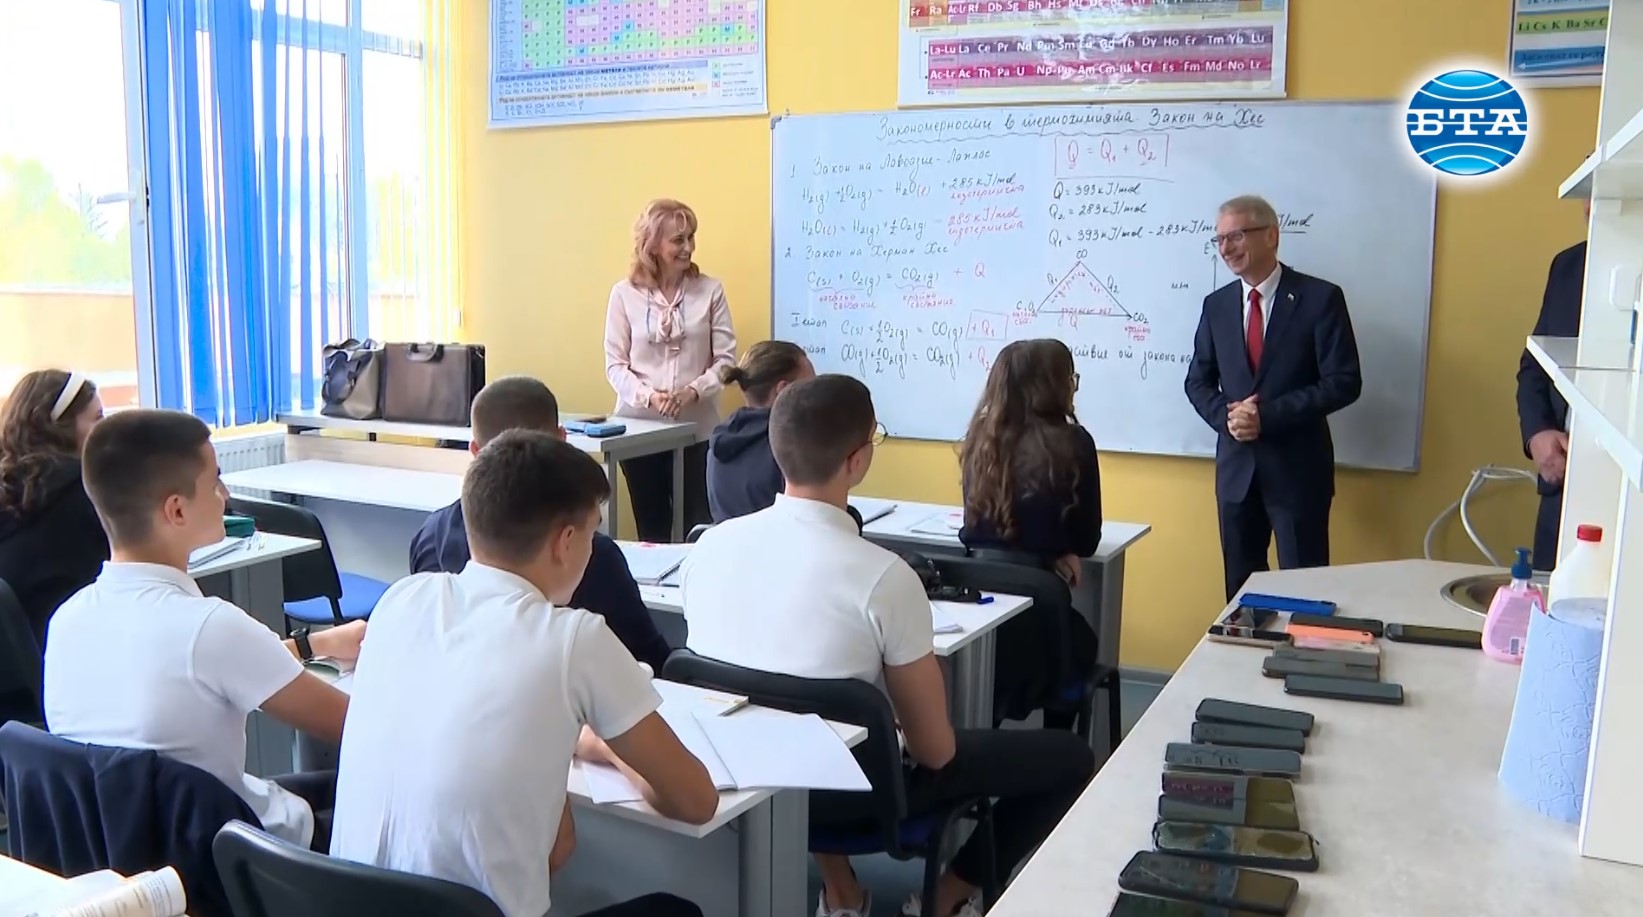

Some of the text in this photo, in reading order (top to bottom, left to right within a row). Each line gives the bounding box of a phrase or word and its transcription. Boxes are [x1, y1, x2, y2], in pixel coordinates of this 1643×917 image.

[968, 4, 979, 12] Rf
[988, 2, 1002, 12] Db
[1533, 22, 1546, 30] Cs
[1552, 20, 1560, 29] K
[930, 45, 956, 54] La-Lu
[958, 44, 970, 54] La
[978, 43, 991, 52] Ce
[998, 43, 1008, 52] Pr
[1017, 41, 1032, 51] Nd
[1142, 37, 1157, 48] Dy
[1164, 36, 1180, 47] Ho
[1207, 35, 1224, 45] Tm
[1229, 34, 1244, 44] Yb
[1251, 33, 1264, 44] Lu
[930, 69, 956, 79] Ac-Lr
[958, 69, 971, 78] Ac
[978, 68, 991, 78] Th
[998, 68, 1010, 77] Pa
[1017, 67, 1025, 76] U
[1141, 63, 1152, 73] Cf
[1163, 63, 1174, 72] Es
[1184, 62, 1200, 71] Fm
[1206, 61, 1222, 71] Md
[1228, 60, 1245, 70] No
[1251, 60, 1262, 69] Lr
[1149, 108, 1194, 126] Закон
[1204, 111, 1224, 122] на
[1234, 109, 1265, 125] Хес
[813, 157, 852, 176] Закон
[806, 246, 842, 260] Закон
[850, 249, 863, 257] на
